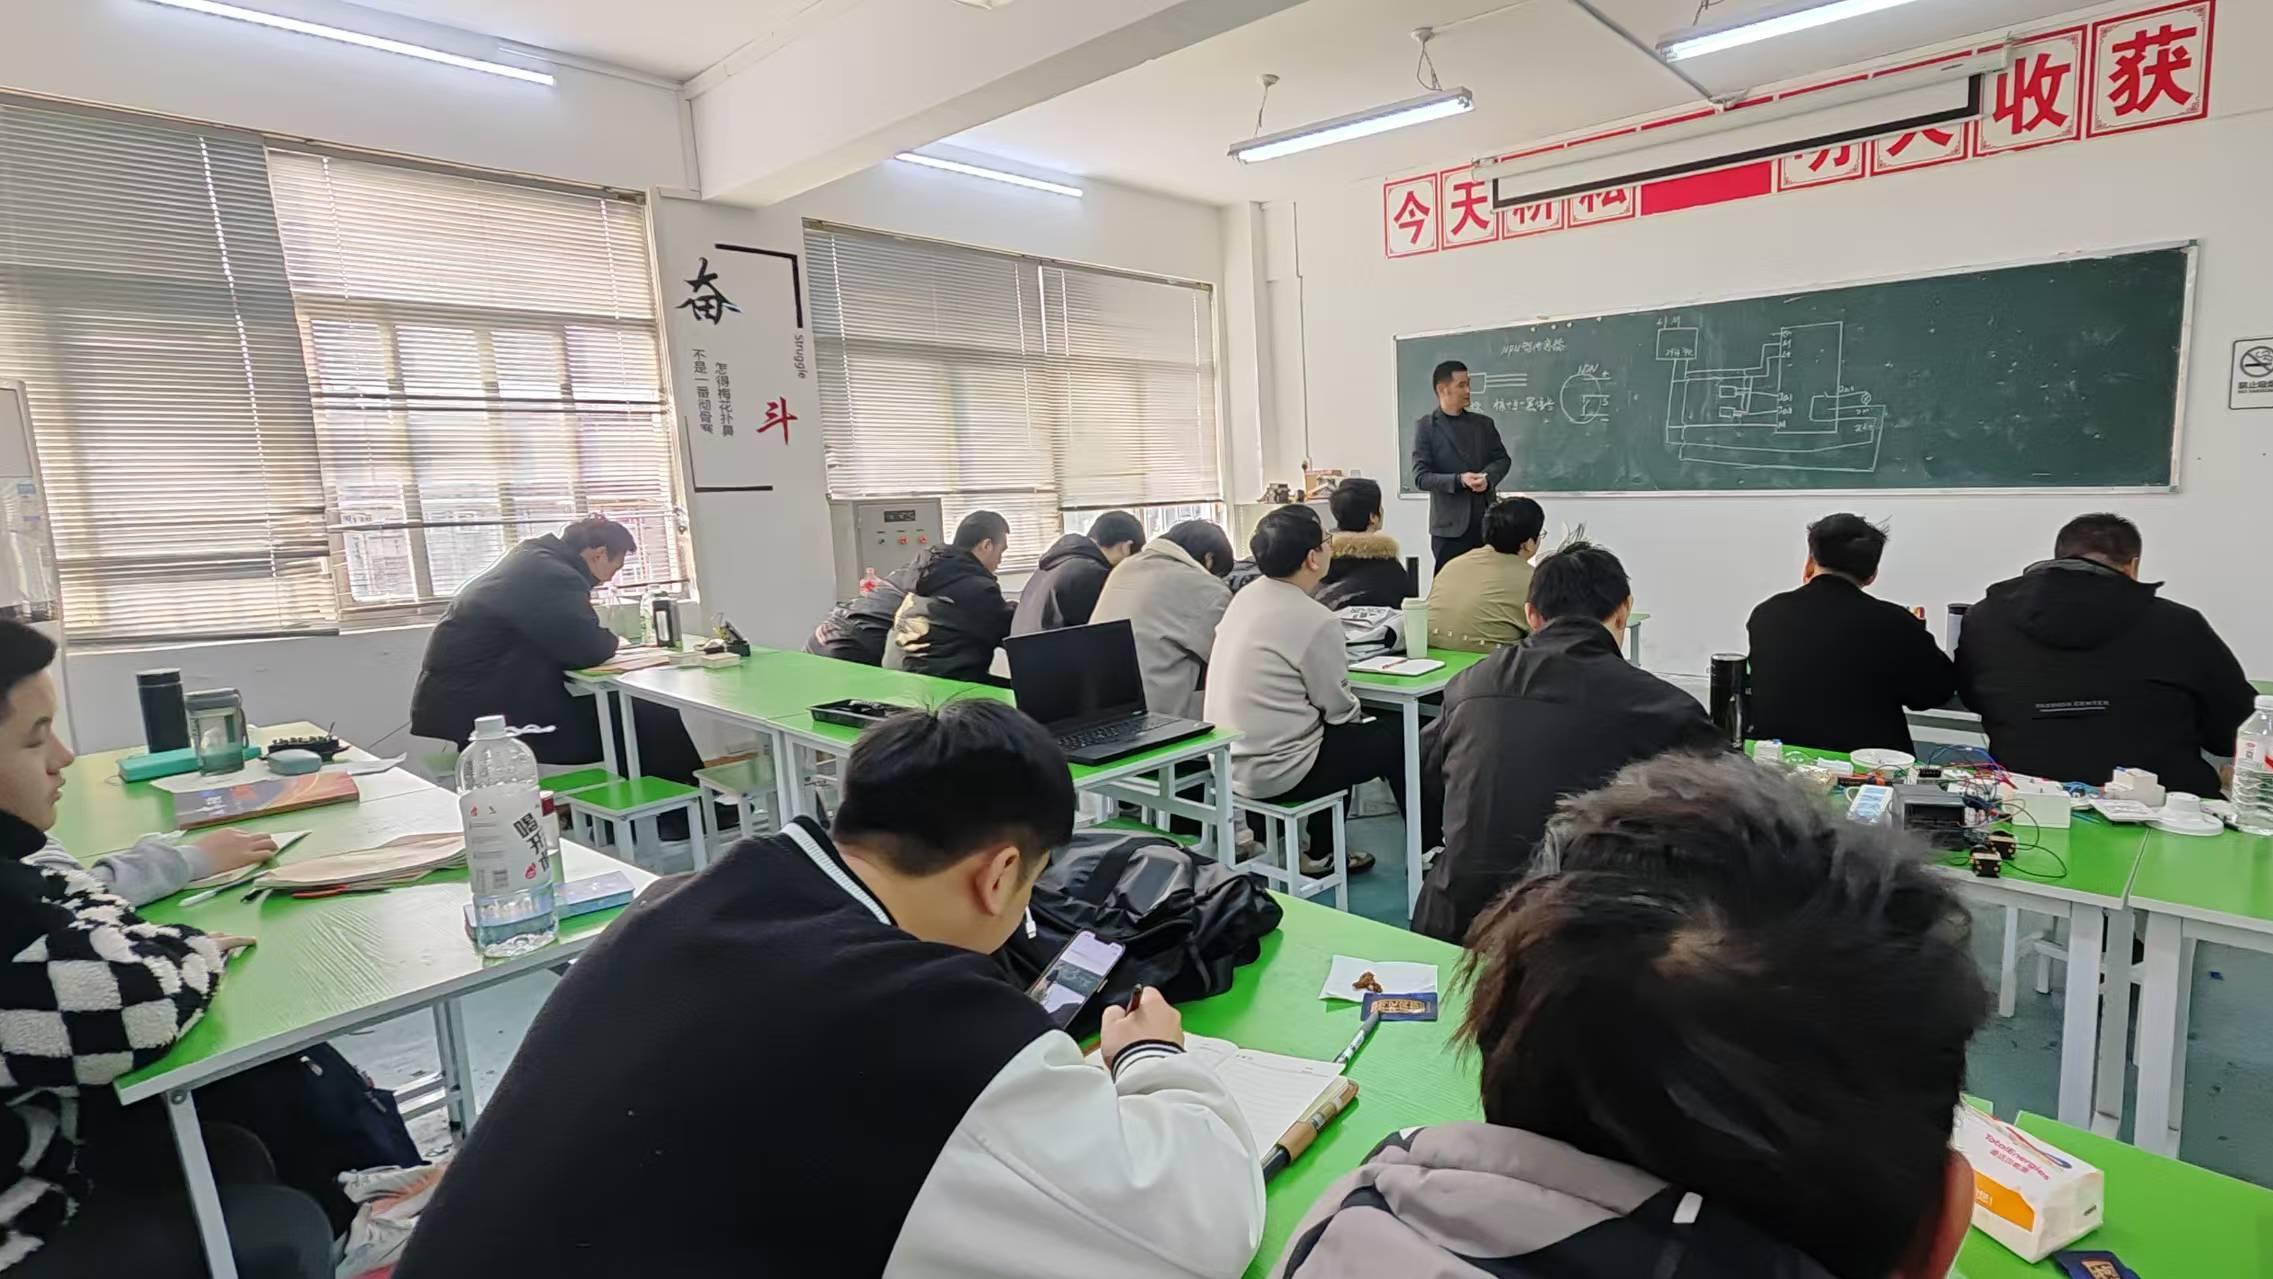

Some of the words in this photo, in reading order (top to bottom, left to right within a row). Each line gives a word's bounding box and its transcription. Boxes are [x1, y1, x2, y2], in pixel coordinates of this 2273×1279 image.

[675, 257, 743, 325] 奋
[756, 396, 798, 445] 斗
[1984, 1132, 2049, 1180] TotalEnergies
